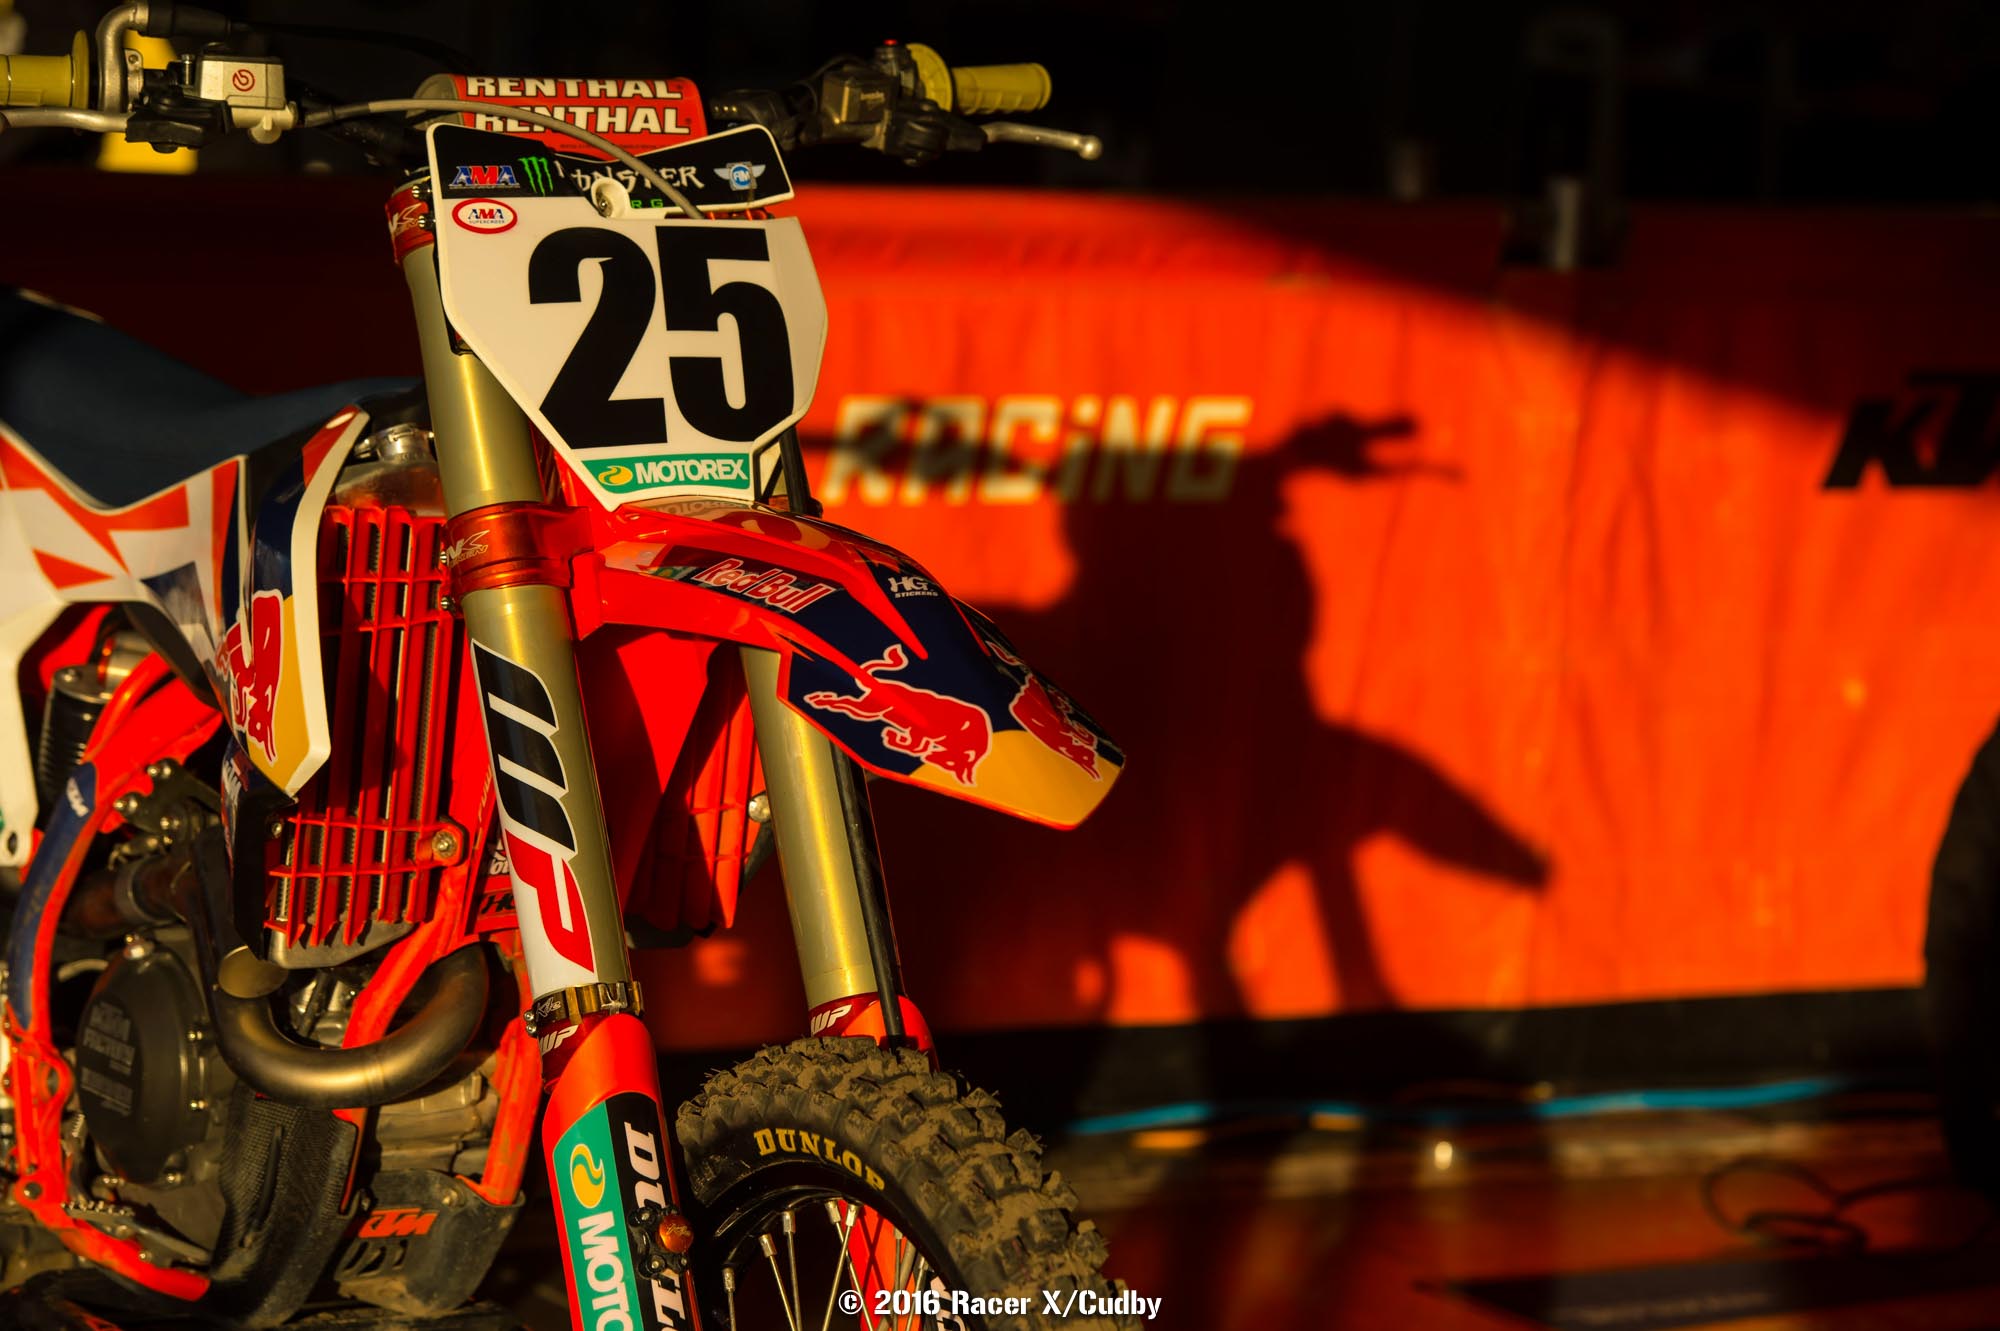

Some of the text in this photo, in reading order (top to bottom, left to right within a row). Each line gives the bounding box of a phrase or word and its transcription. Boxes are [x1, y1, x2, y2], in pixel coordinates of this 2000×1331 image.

[466, 76, 682, 99] RENTHAL
[450, 165, 519, 187] AMA
[468, 208, 505, 219] AMA
[528, 225, 795, 450] 25
[634, 458, 749, 485] MOTOREX
[887, 576, 929, 592] HG
[895, 591, 938, 599] STICKERS
[754, 1127, 885, 1191] DUNLOP
[357, 1207, 439, 1239] KTM
